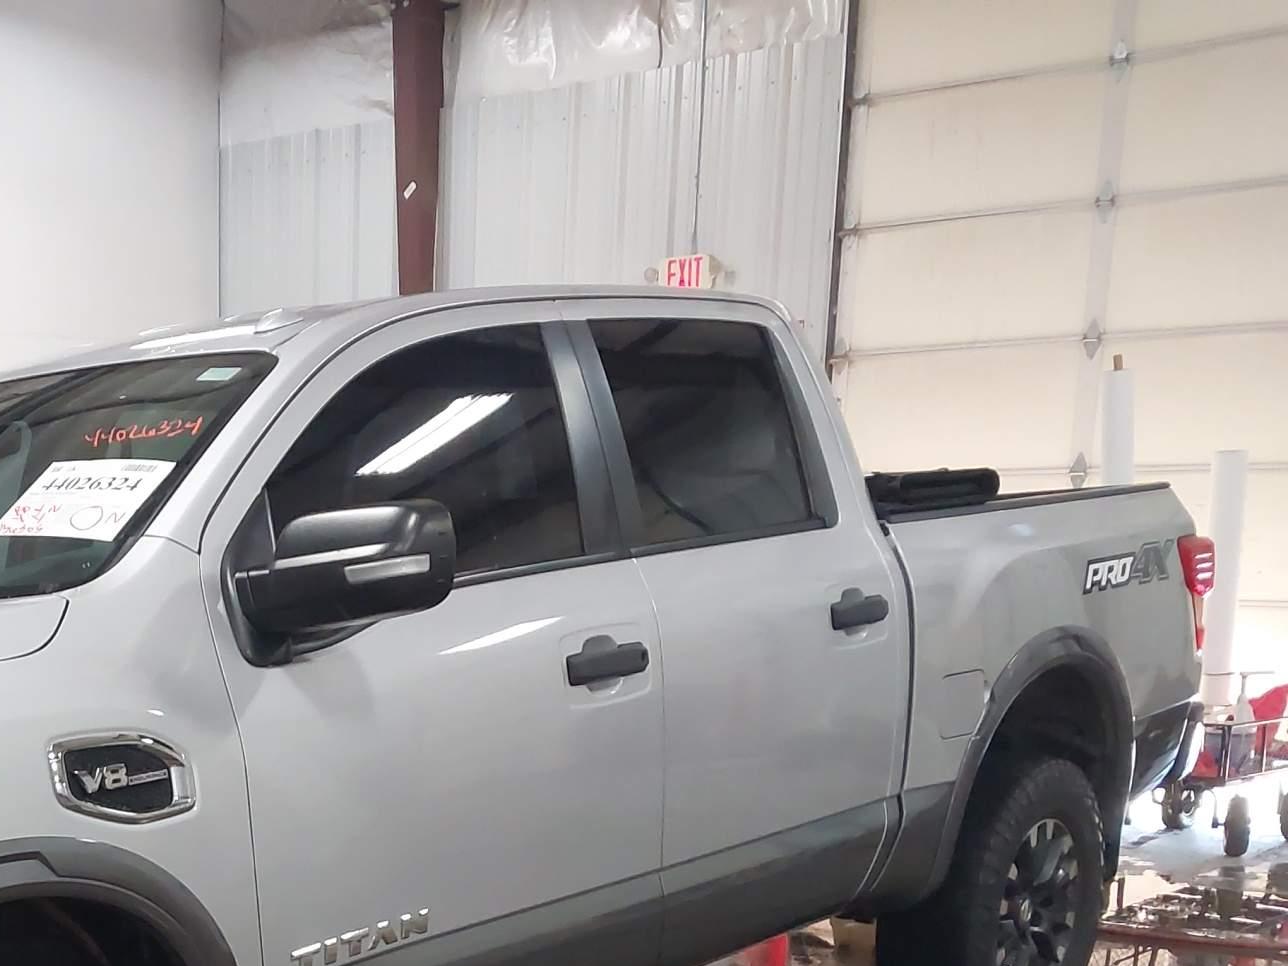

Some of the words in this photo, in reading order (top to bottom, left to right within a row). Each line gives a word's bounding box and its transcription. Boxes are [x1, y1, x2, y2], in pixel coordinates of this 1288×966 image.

[667, 256, 703, 287] EXIT
[42, 476, 143, 491] 44026324
[73, 763, 128, 794] V8
